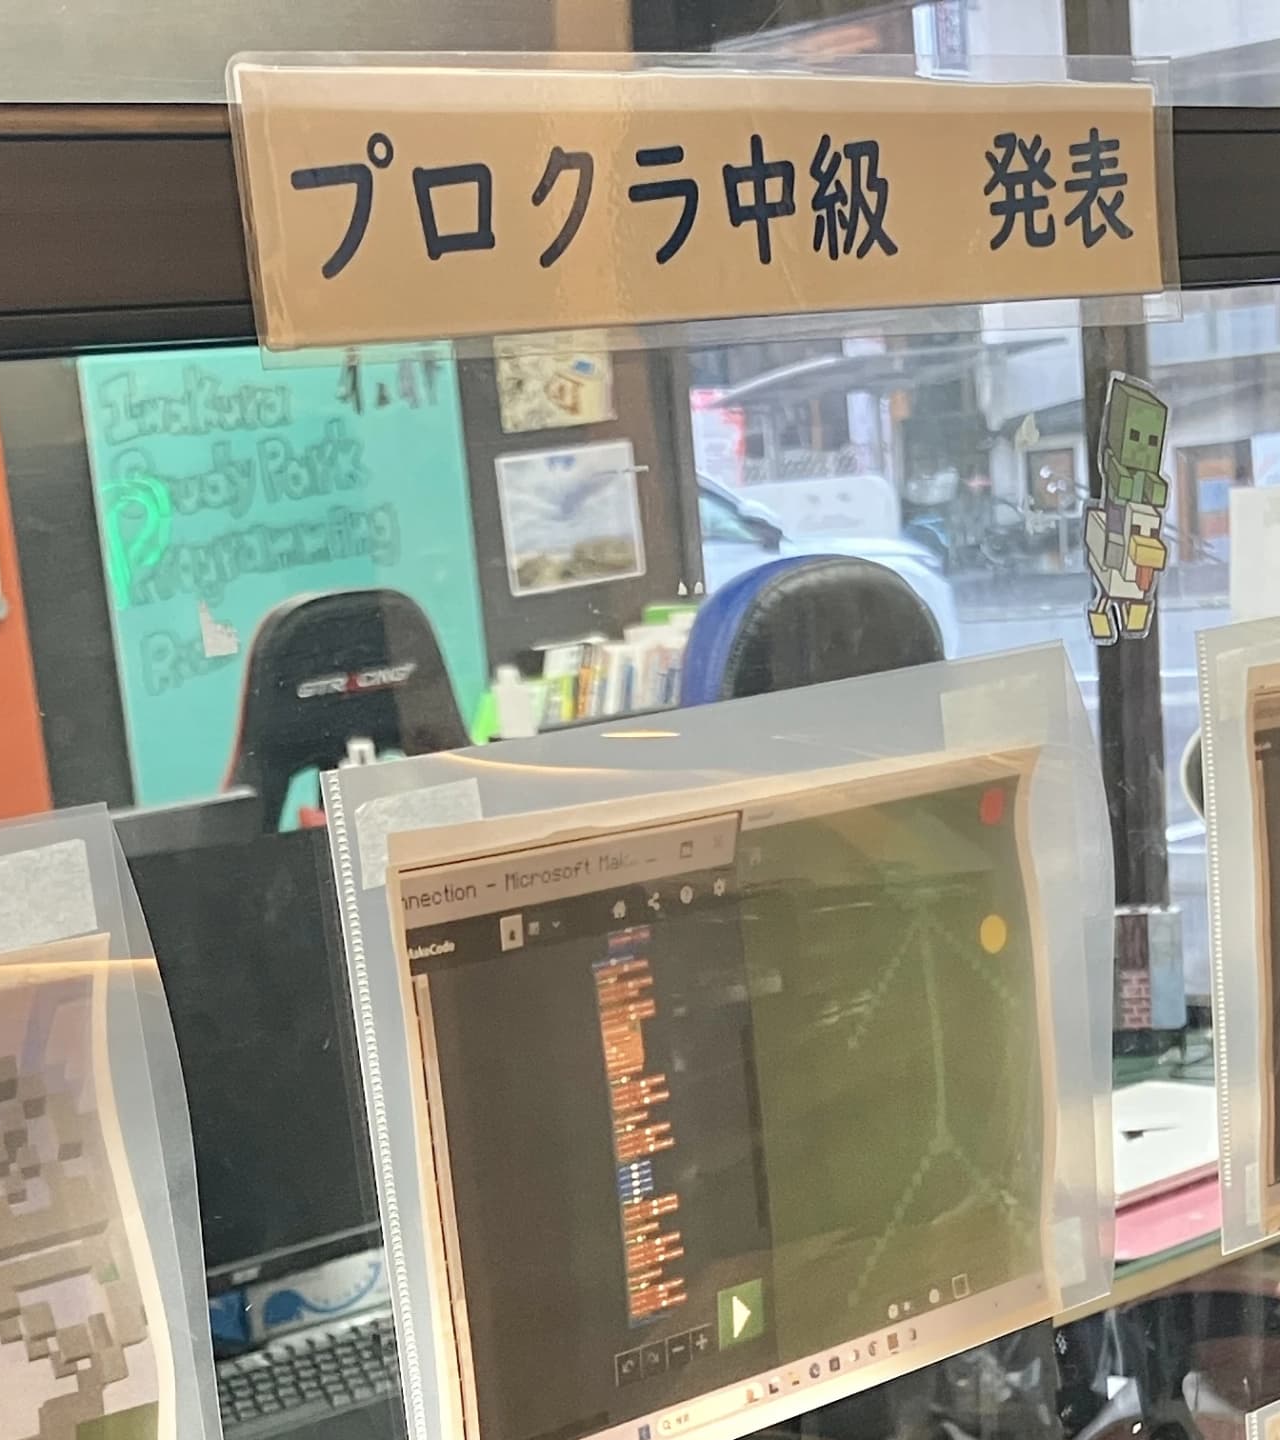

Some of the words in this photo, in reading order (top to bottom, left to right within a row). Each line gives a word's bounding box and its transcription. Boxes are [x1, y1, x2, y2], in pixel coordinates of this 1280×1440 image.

[290, 131, 899, 279] プロクラ中級
[983, 126, 1134, 250] 発表
[504, 861, 591, 893] Microsoft
